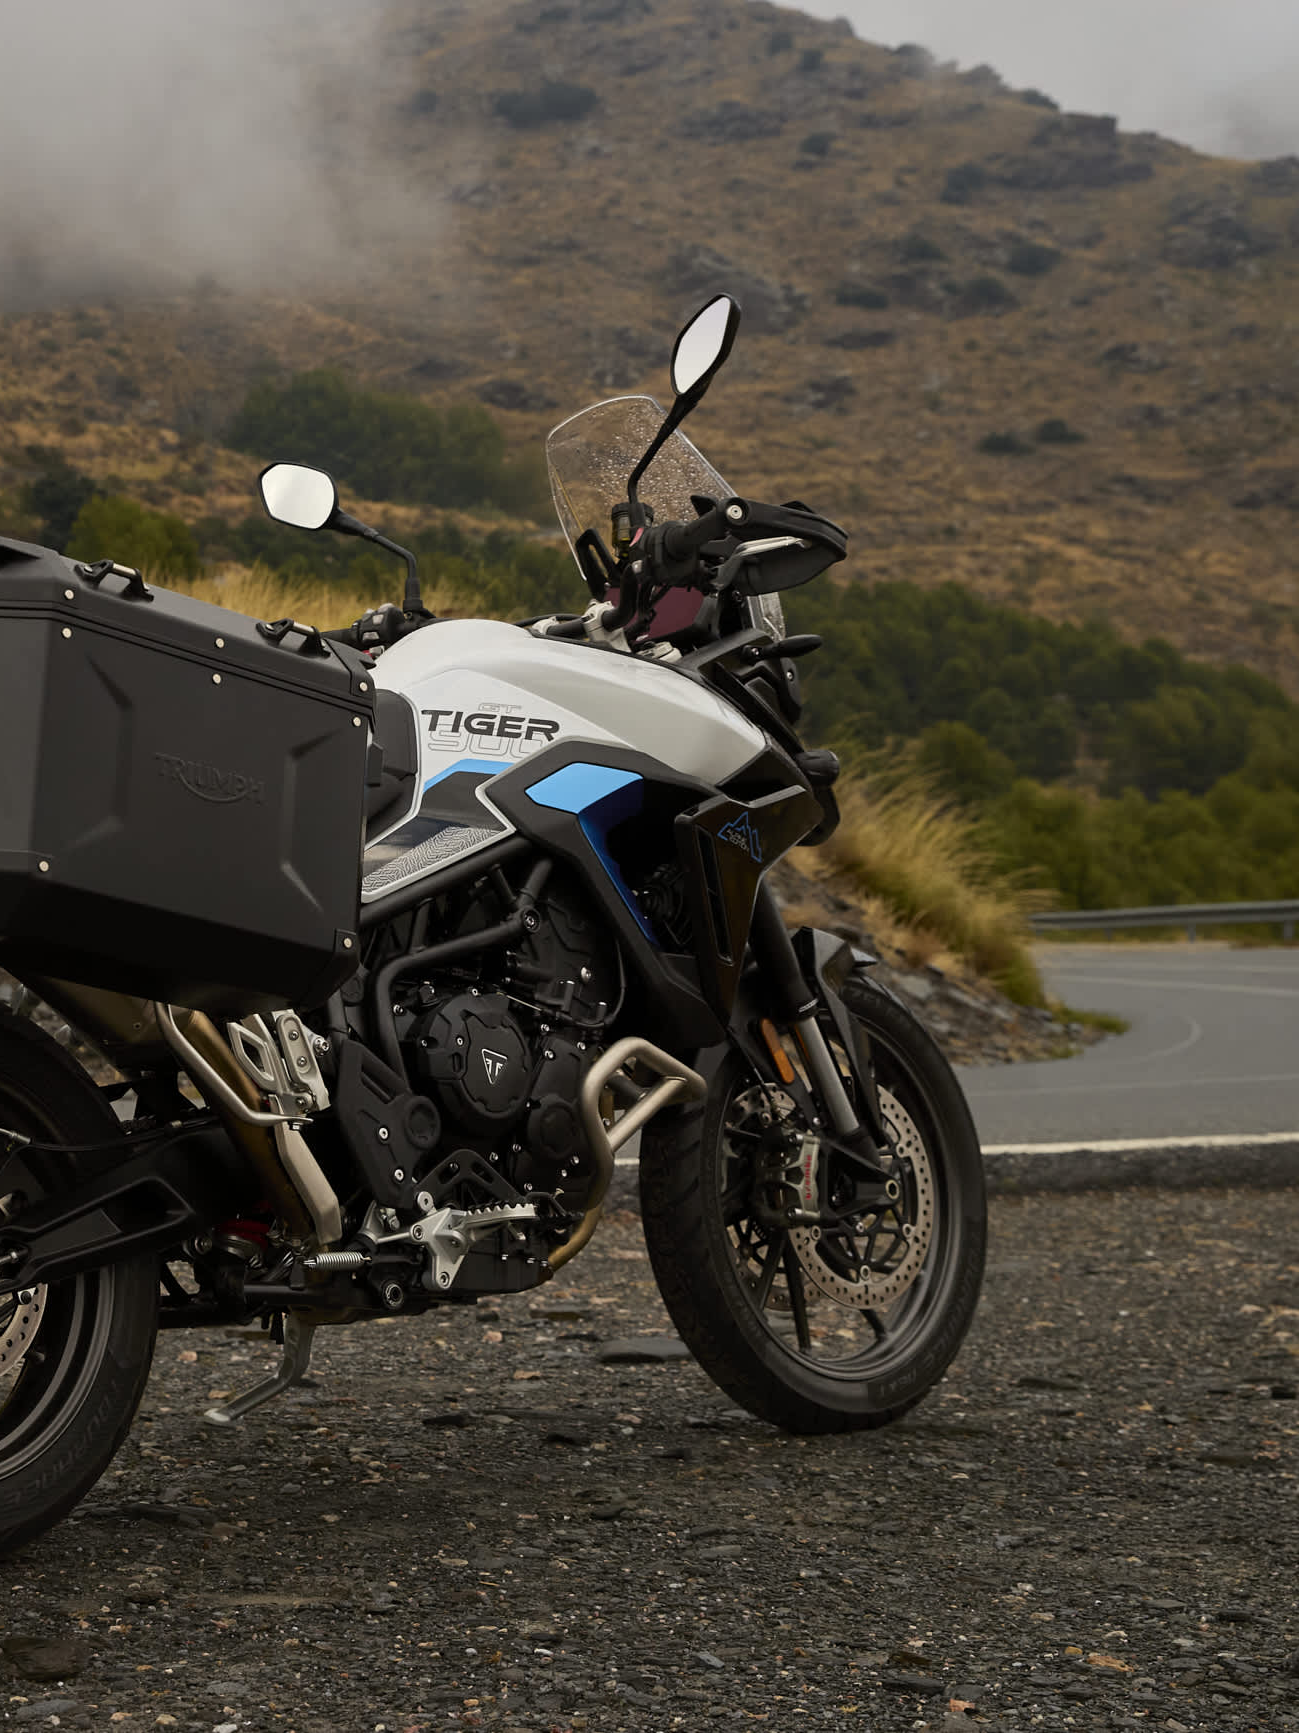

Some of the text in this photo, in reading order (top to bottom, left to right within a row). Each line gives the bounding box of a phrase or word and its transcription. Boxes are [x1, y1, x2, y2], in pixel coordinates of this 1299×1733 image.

[478, 702, 522, 714] GT
[421, 709, 560, 741] TIGER
[153, 752, 267, 807] TRIUMPH
